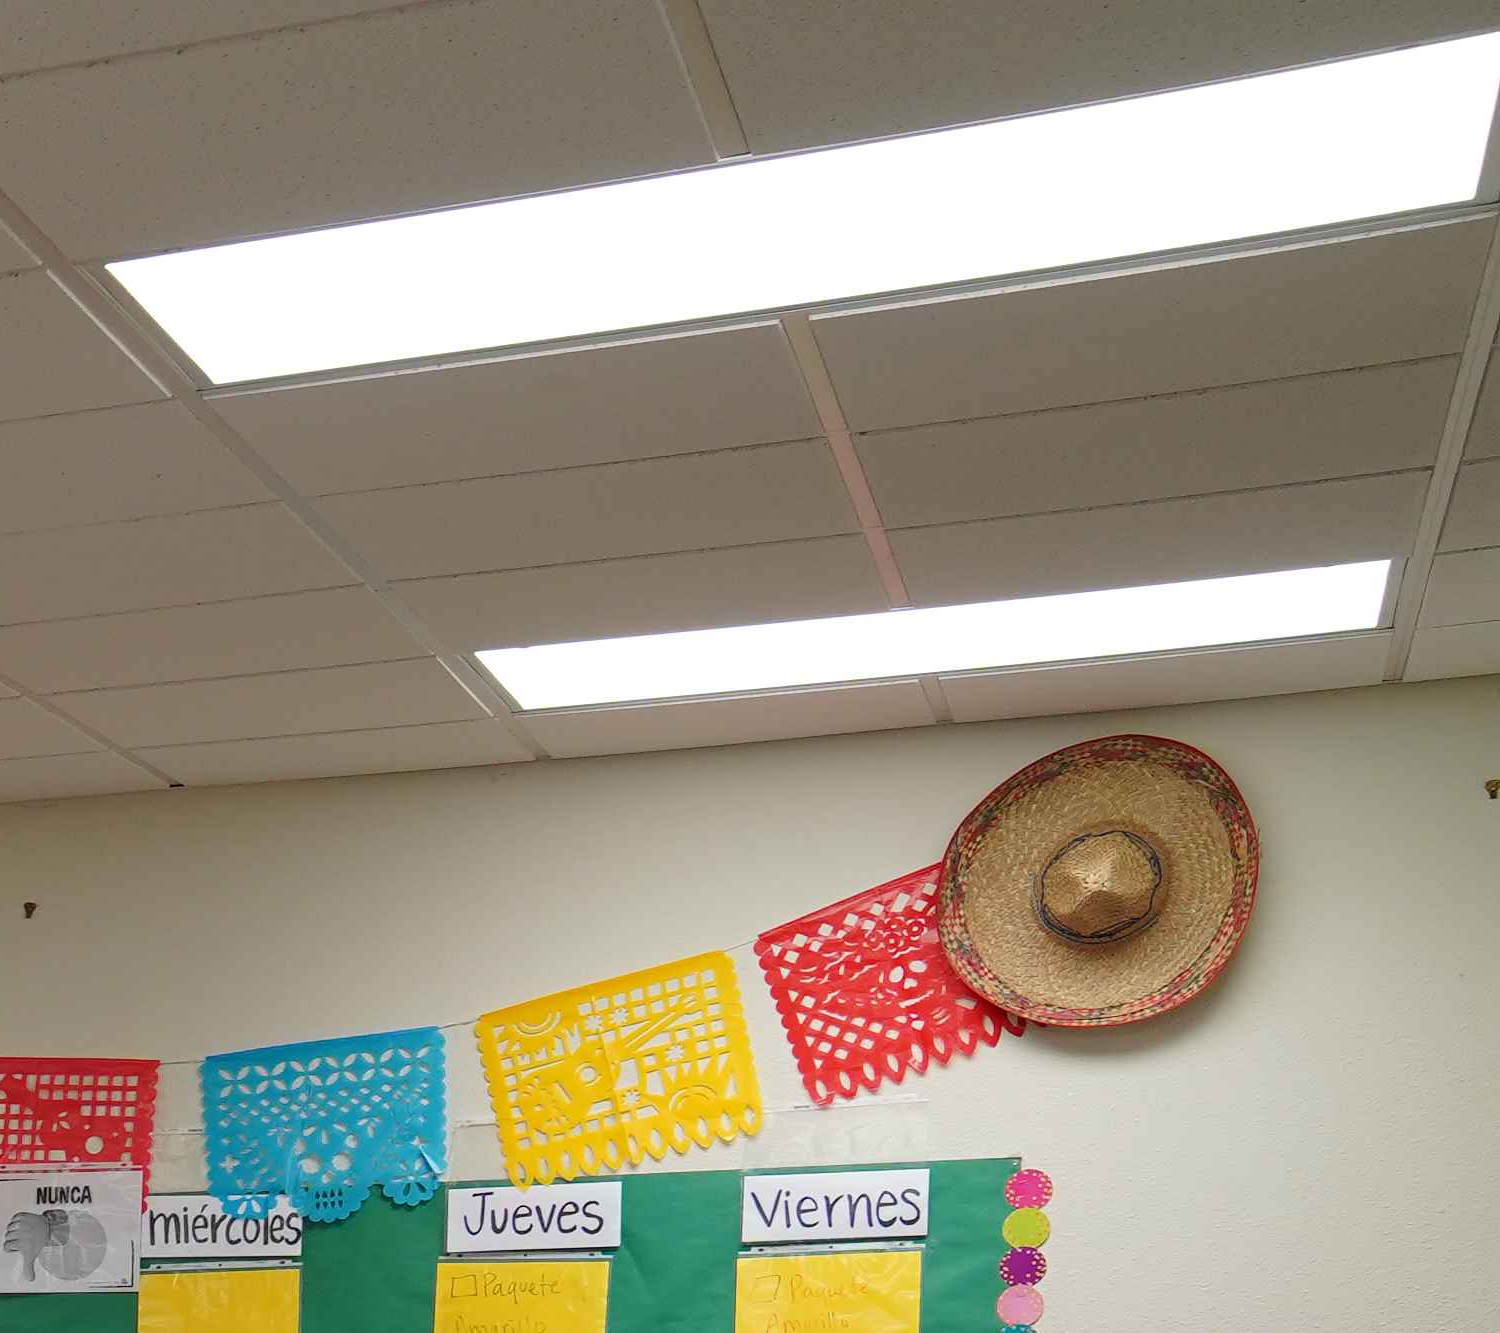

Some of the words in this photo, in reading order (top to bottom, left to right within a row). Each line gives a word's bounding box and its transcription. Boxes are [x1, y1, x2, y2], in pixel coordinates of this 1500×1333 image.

[36, 1185, 92, 1206] NUNCA
[463, 1189, 605, 1239] Jueves
[752, 1184, 921, 1230] Viernes
[149, 1204, 301, 1247] miércoles
[484, 1272, 562, 1304] Paquete
